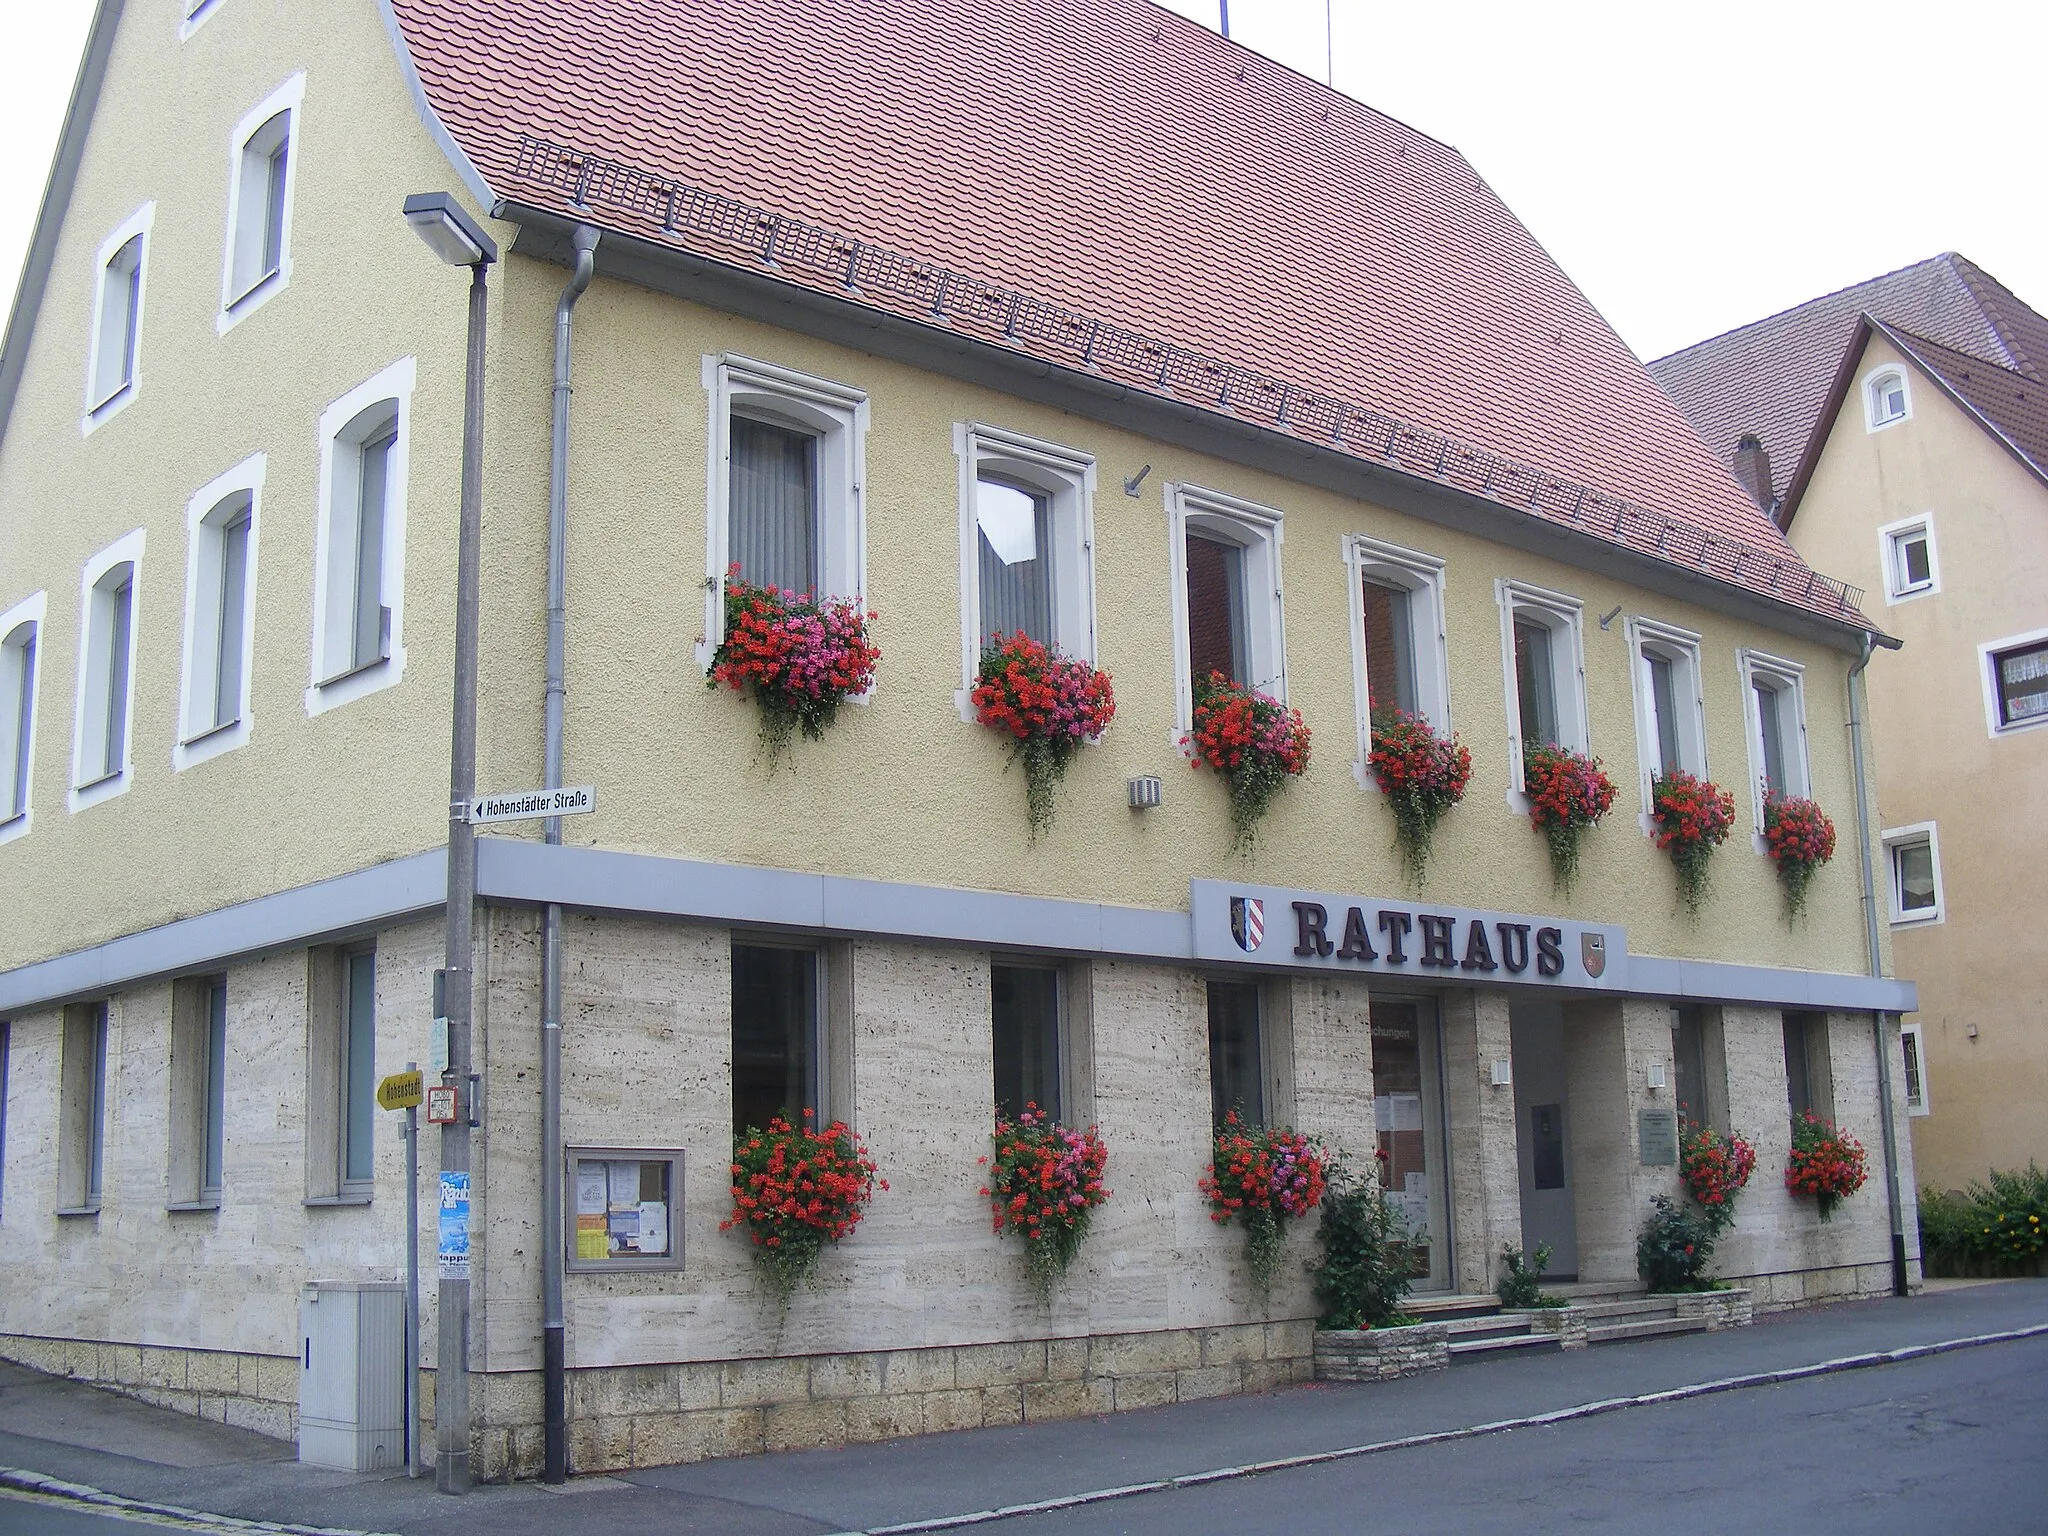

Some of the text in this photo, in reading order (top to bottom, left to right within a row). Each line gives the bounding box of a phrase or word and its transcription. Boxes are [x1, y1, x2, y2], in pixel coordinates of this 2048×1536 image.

[487, 790, 587, 816] Hohenstädter Straße
[1291, 901, 1565, 976] RATHAUS
[386, 1077, 420, 1101] Hohenstadt
